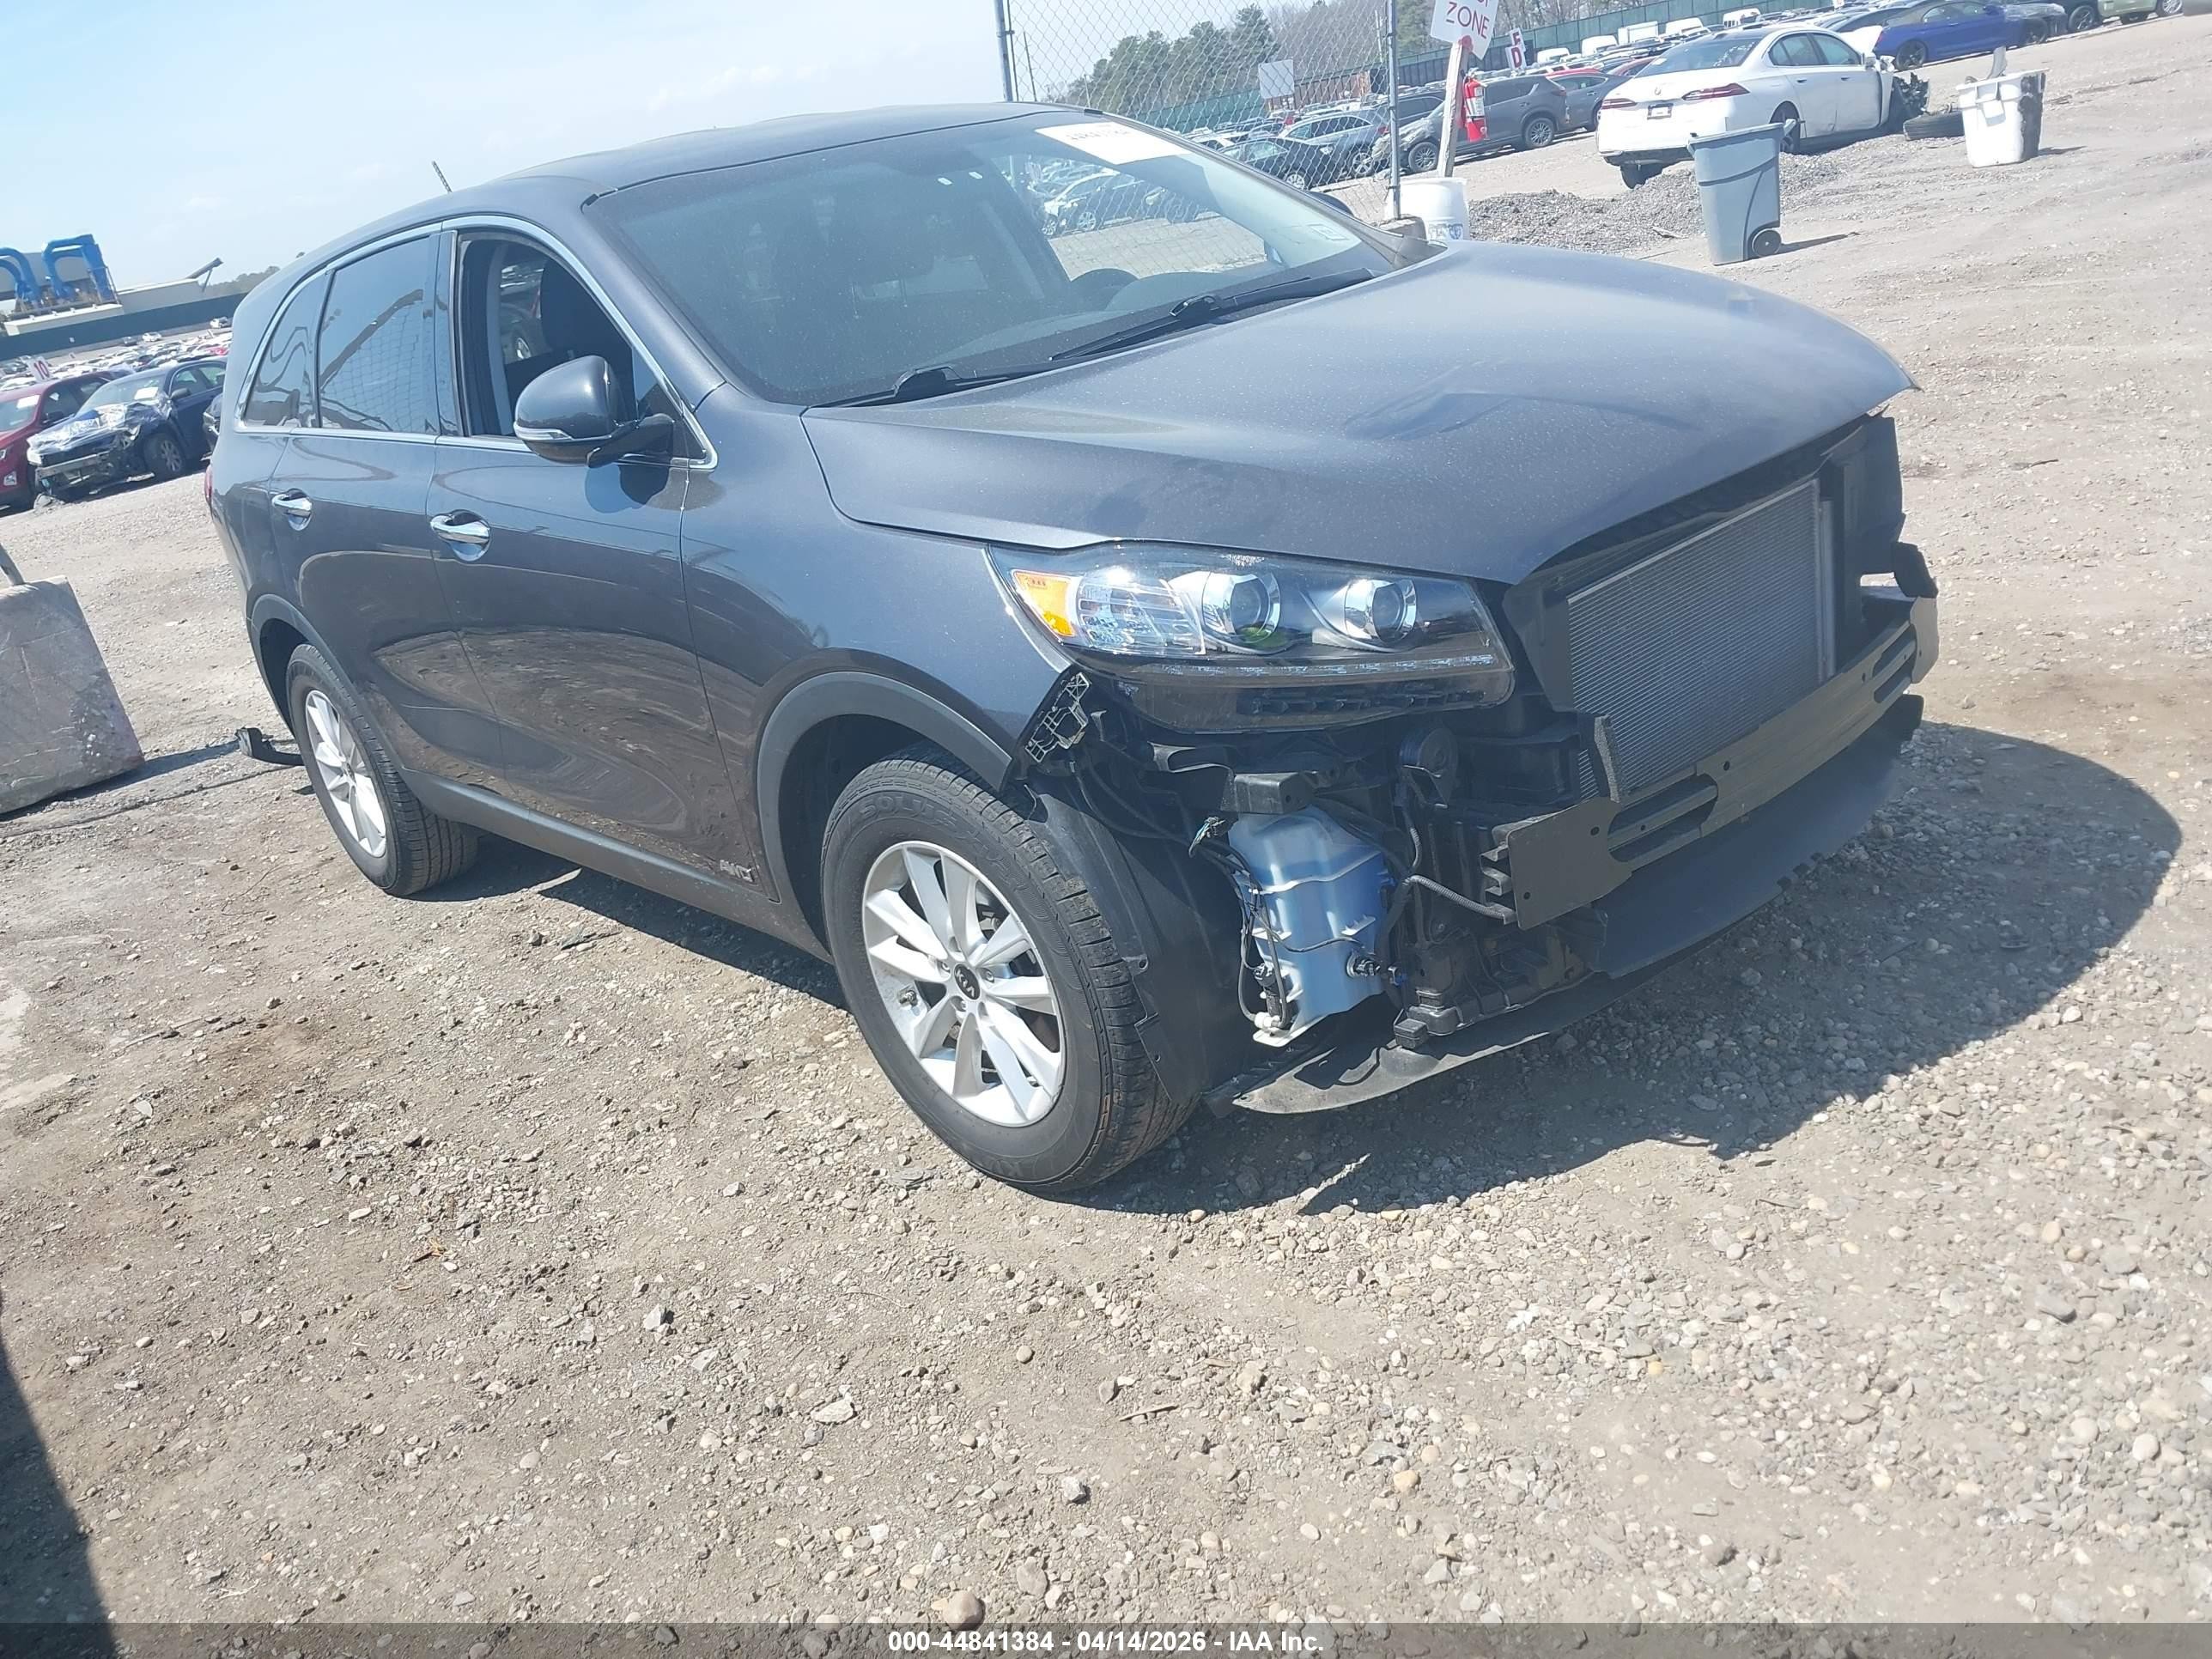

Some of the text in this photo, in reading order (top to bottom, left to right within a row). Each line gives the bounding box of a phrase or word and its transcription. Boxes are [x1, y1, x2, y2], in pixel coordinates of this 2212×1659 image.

[1446, 1, 1490, 40] ZONE
[1511, 46, 1522, 69] D
[34, 361, 50, 380] 10
[956, 968, 975, 998] KIA
